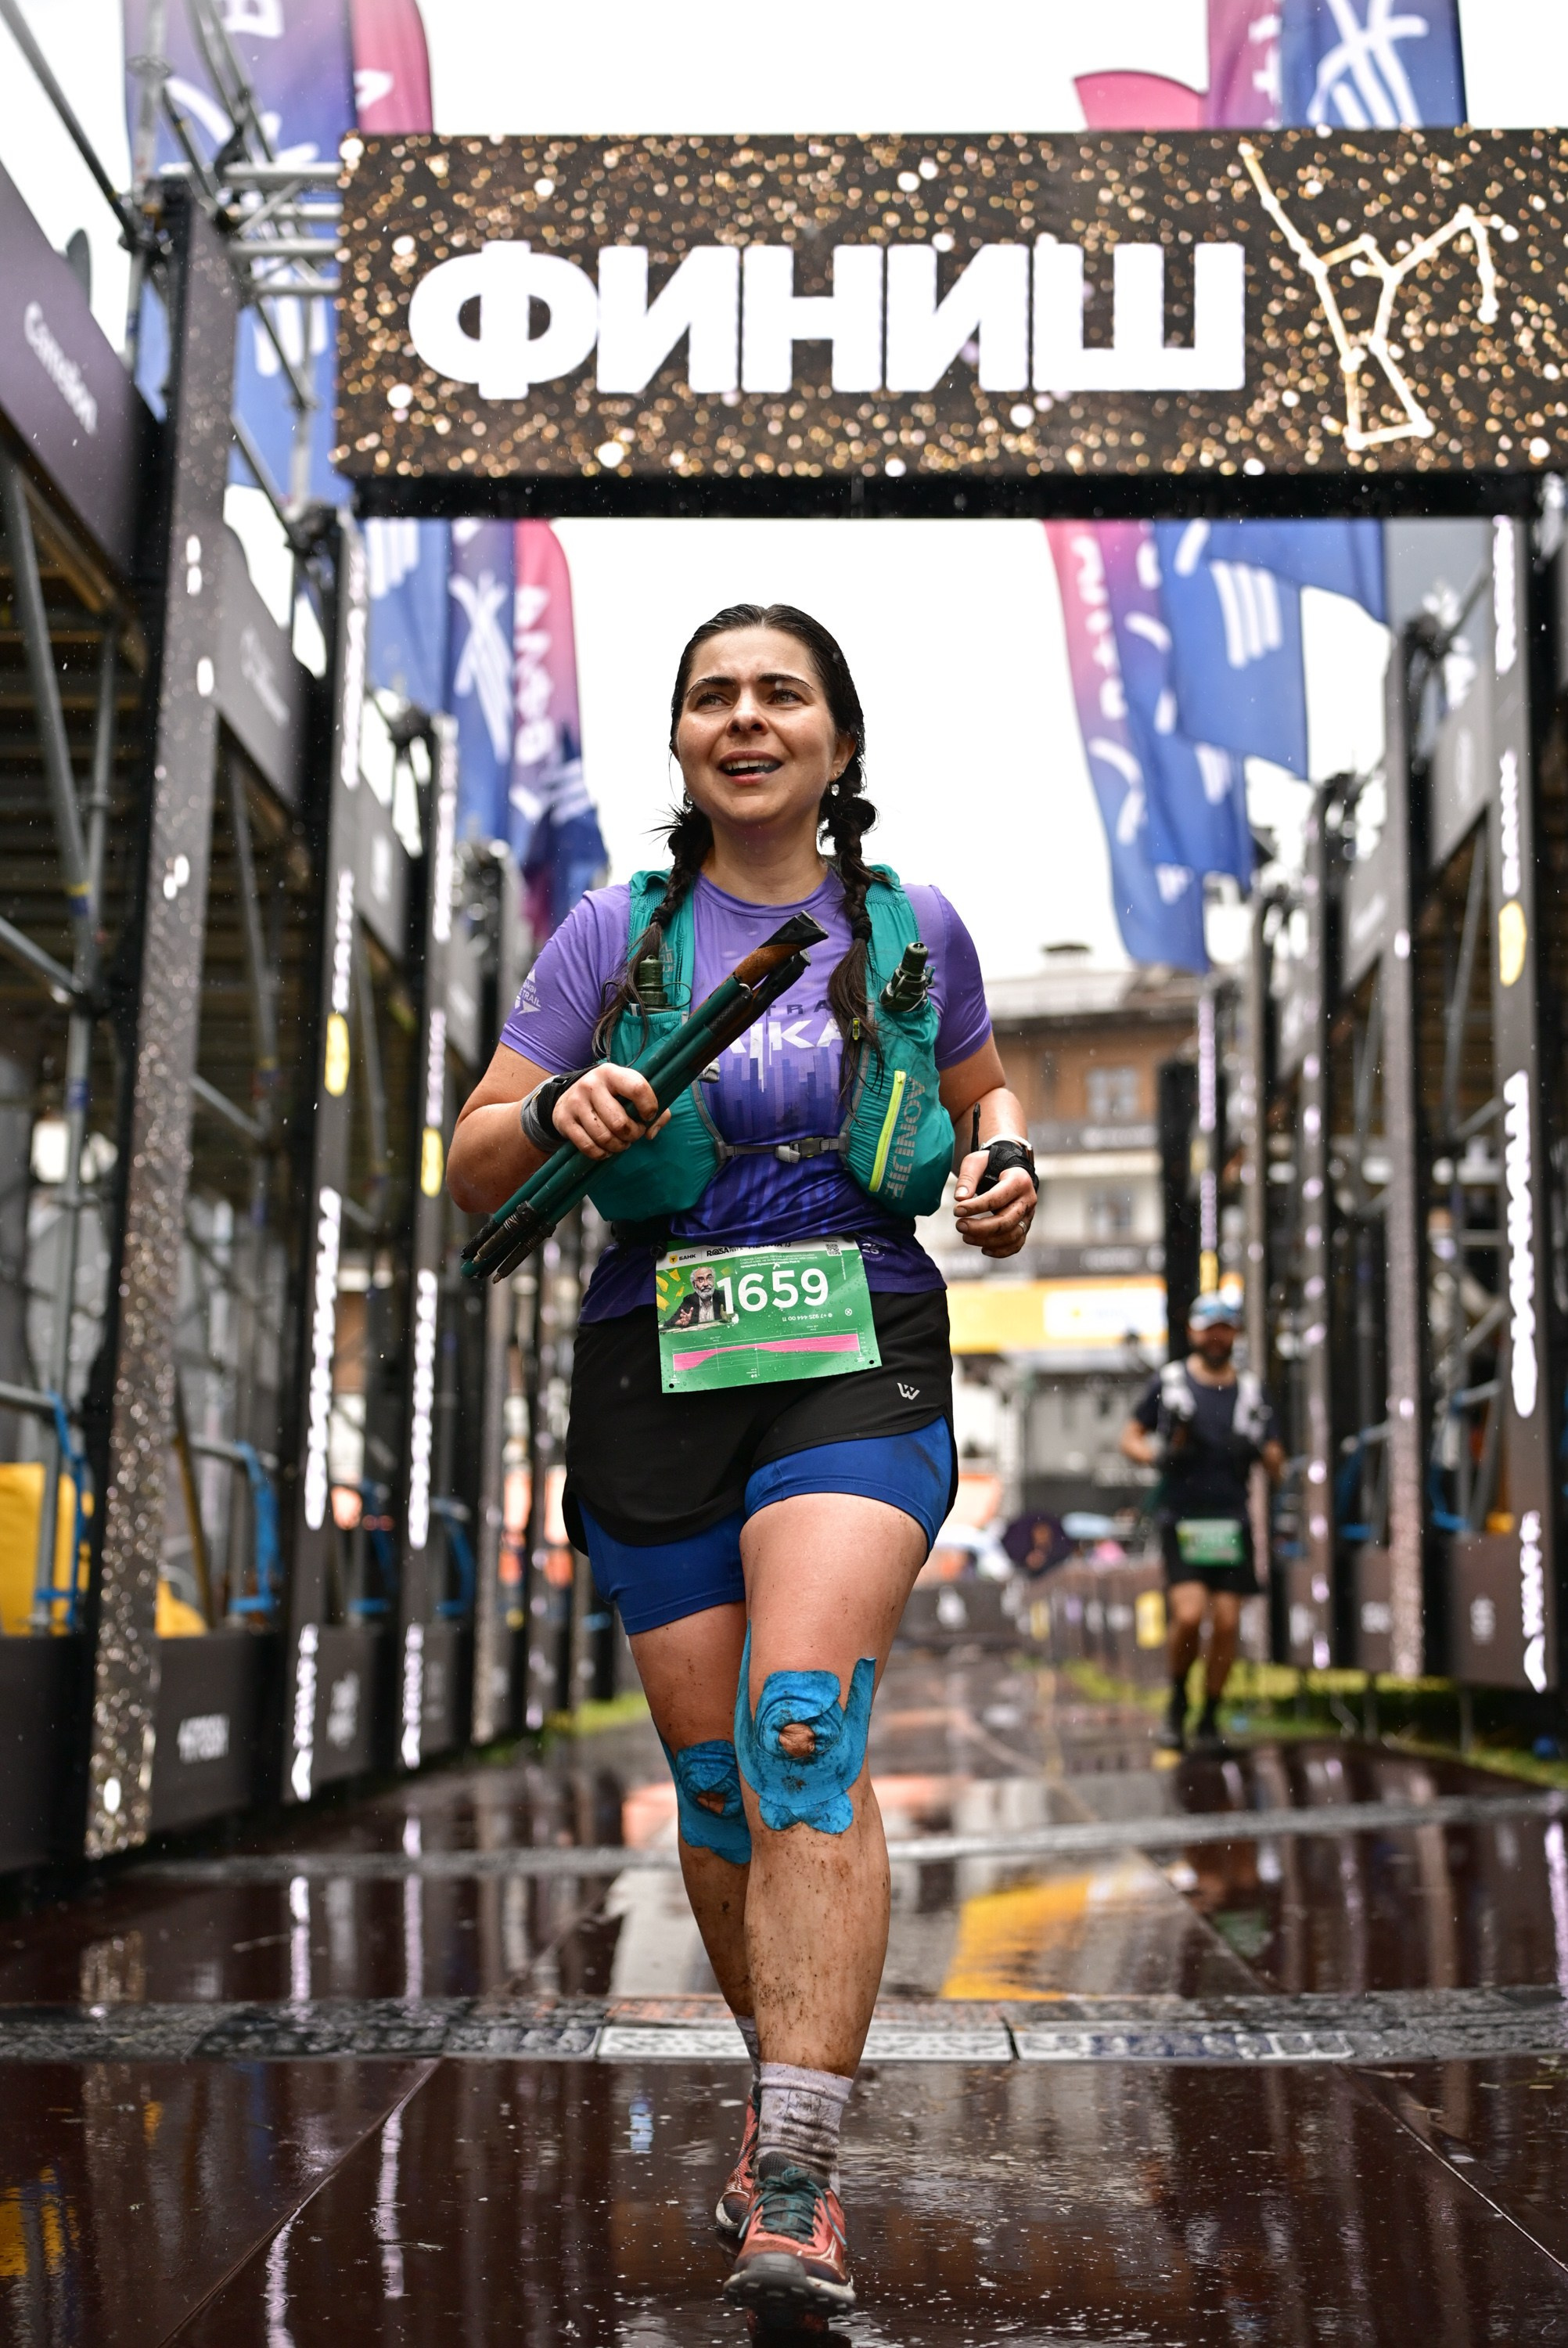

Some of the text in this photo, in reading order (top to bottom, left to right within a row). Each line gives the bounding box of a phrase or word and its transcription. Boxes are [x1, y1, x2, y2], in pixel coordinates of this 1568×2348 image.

[408, 239, 1245, 400] ФИНИШ
[522, 990, 541, 1007] TRAIL
[766, 999, 833, 1016] TRA
[717, 1268, 829, 1315] 1659
